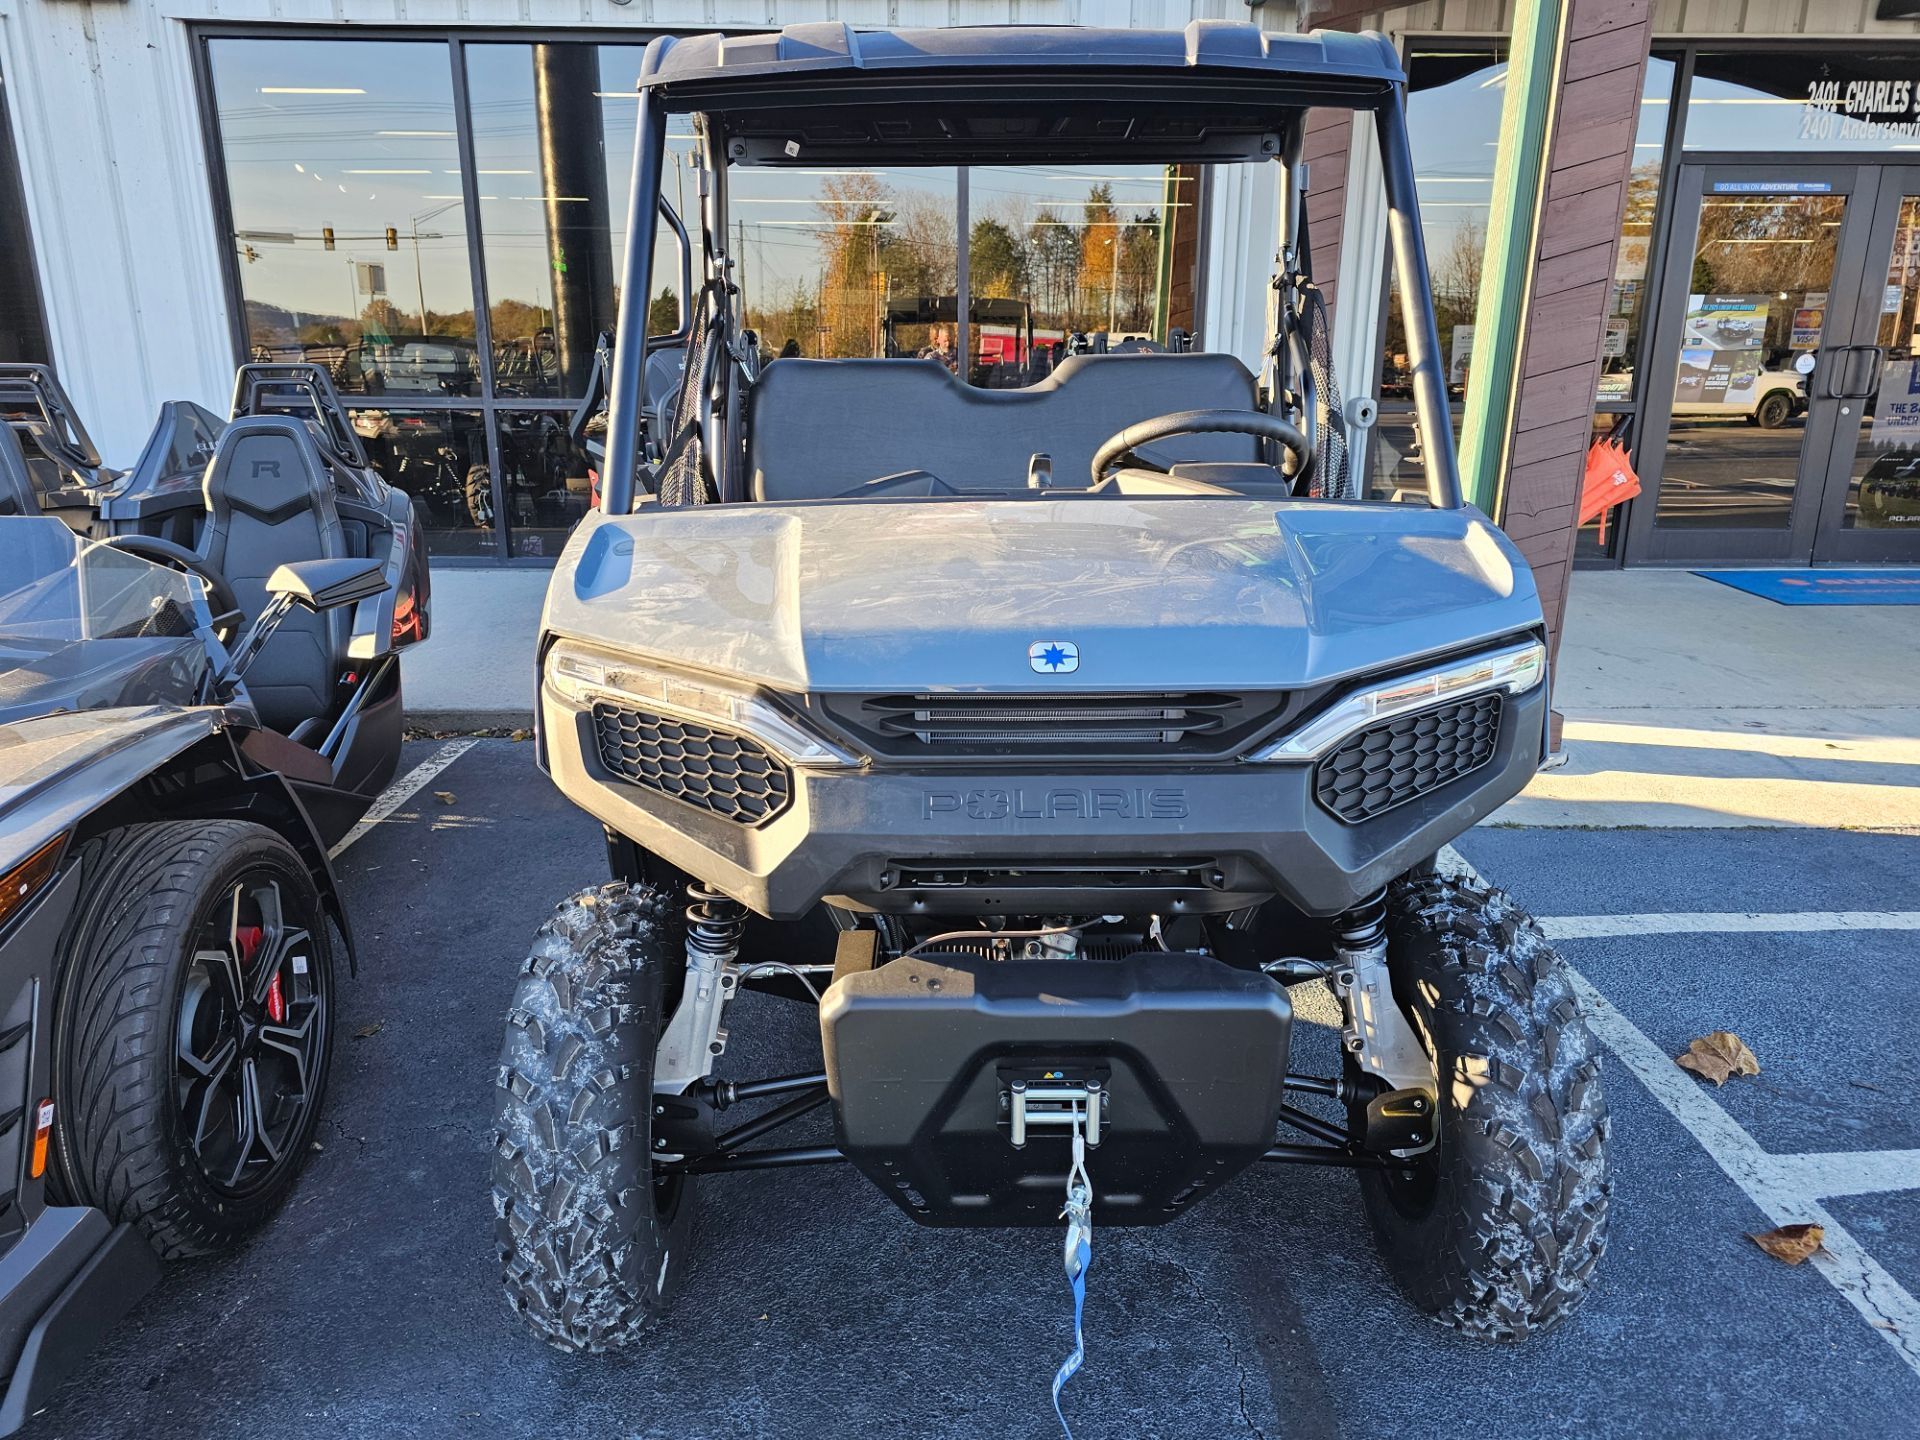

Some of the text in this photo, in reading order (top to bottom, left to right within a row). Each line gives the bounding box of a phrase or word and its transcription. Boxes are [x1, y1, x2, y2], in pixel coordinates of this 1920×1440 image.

[1805, 81, 1840, 113] 2401
[1844, 81, 1911, 113] CHARLES
[1800, 115, 1834, 139] 2401
[1730, 183, 1741, 191] ALL
[1760, 183, 1798, 191] ADVENTURE
[1797, 335, 1814, 343] VISA
[1890, 403, 1908, 413] THE
[1887, 415, 1919, 426] UNDER
[251, 461, 280, 478] R
[921, 788, 1190, 820] POLARIS
